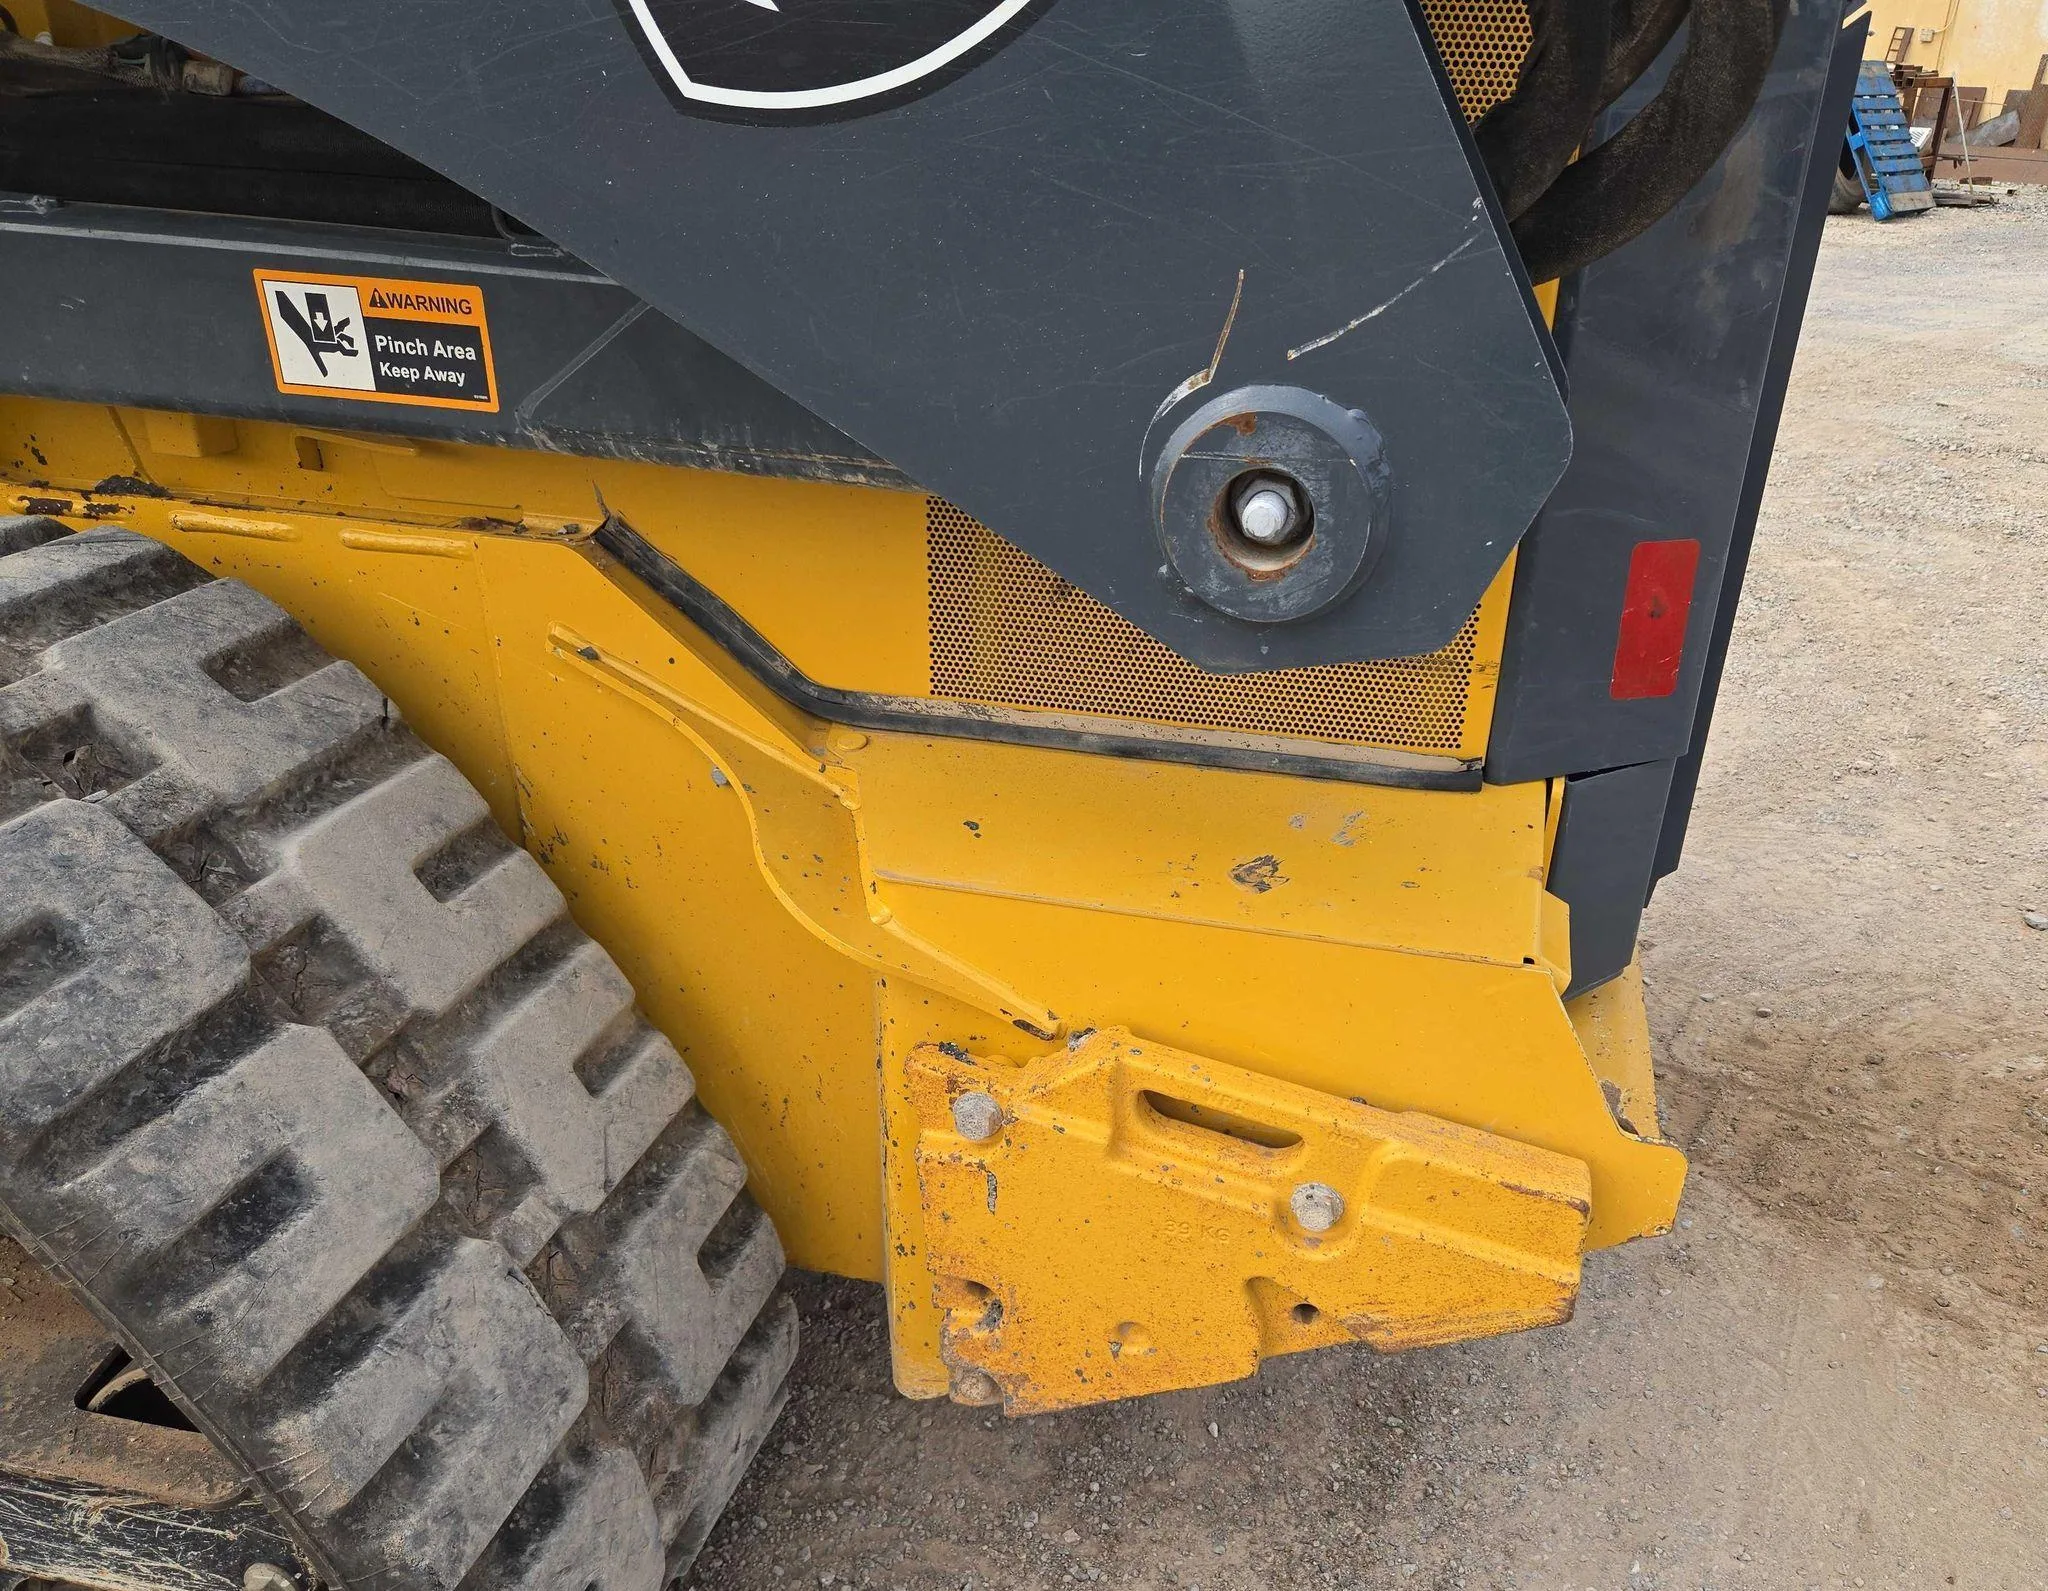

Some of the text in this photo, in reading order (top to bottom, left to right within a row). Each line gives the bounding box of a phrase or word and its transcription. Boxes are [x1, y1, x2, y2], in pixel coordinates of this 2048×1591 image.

[386, 292, 472, 315] WARNING
[374, 334, 477, 361] Pinch Area
[379, 361, 466, 387] Keep Away
